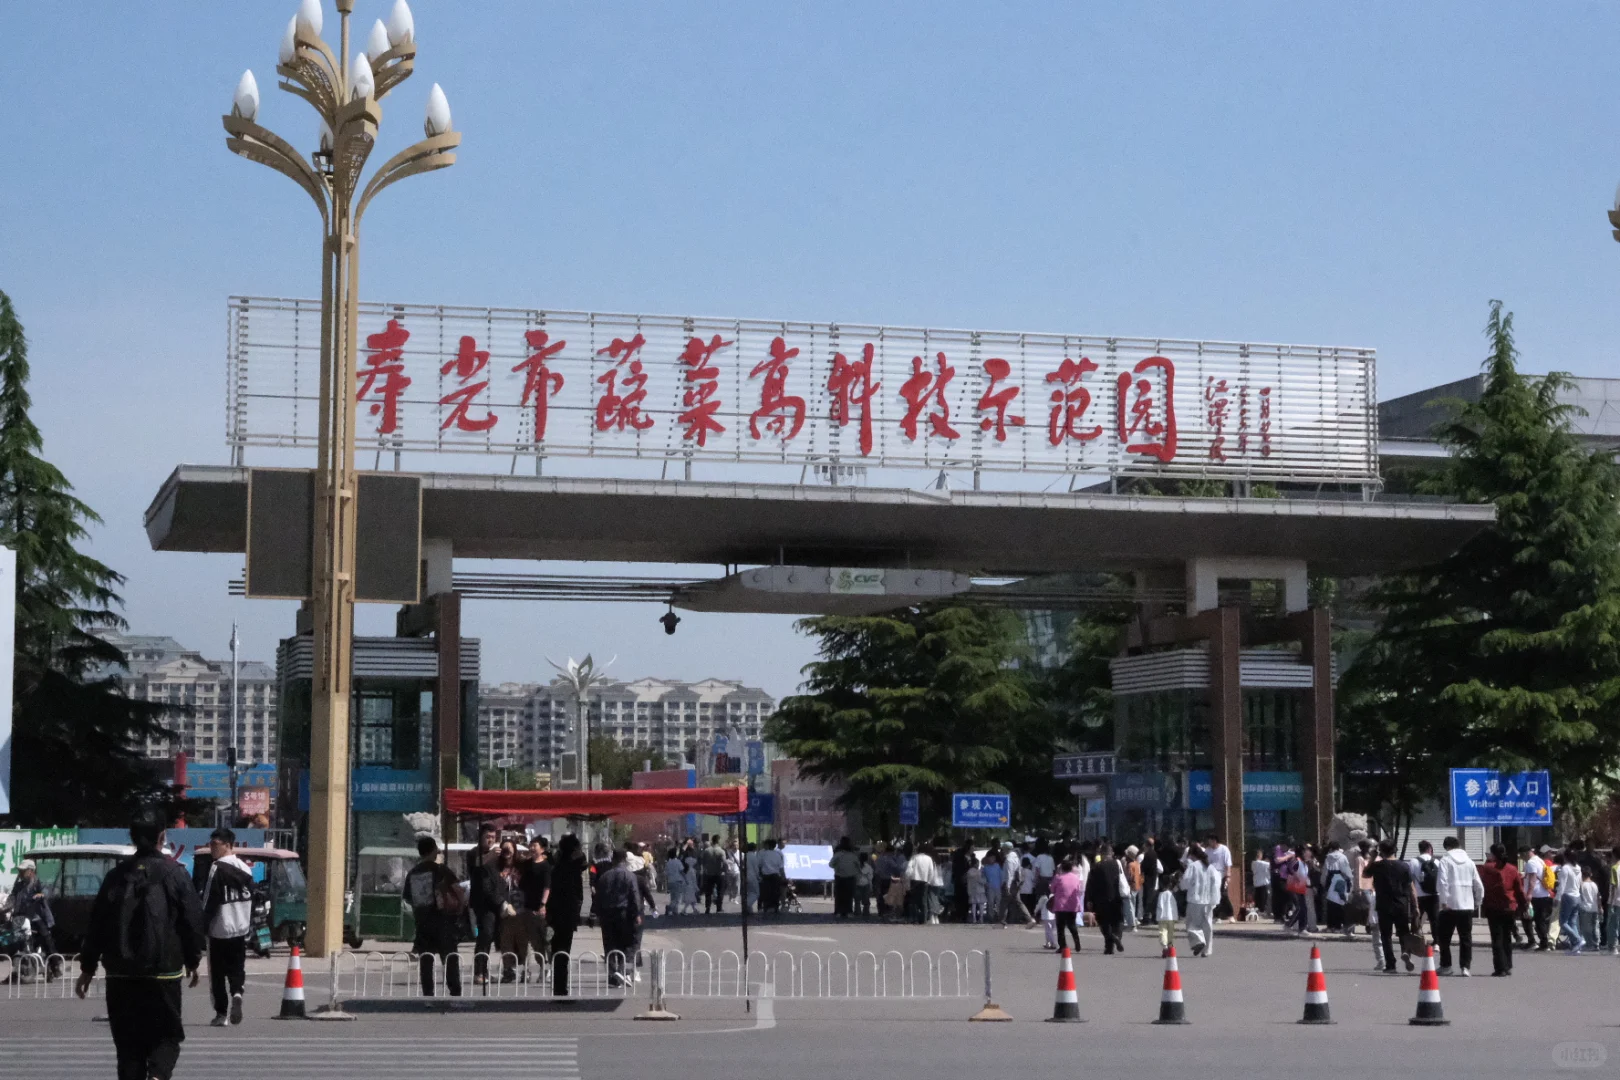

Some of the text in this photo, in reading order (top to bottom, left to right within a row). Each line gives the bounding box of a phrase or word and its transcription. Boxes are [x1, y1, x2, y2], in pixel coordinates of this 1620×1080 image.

[356, 316, 1177, 463] 寿光市蔬菜高科技示范园
[1464, 779, 1539, 797] 参观入口
[960, 799, 1004, 810] 参观入口
[1469, 800, 1536, 808] Visitor Entrance
